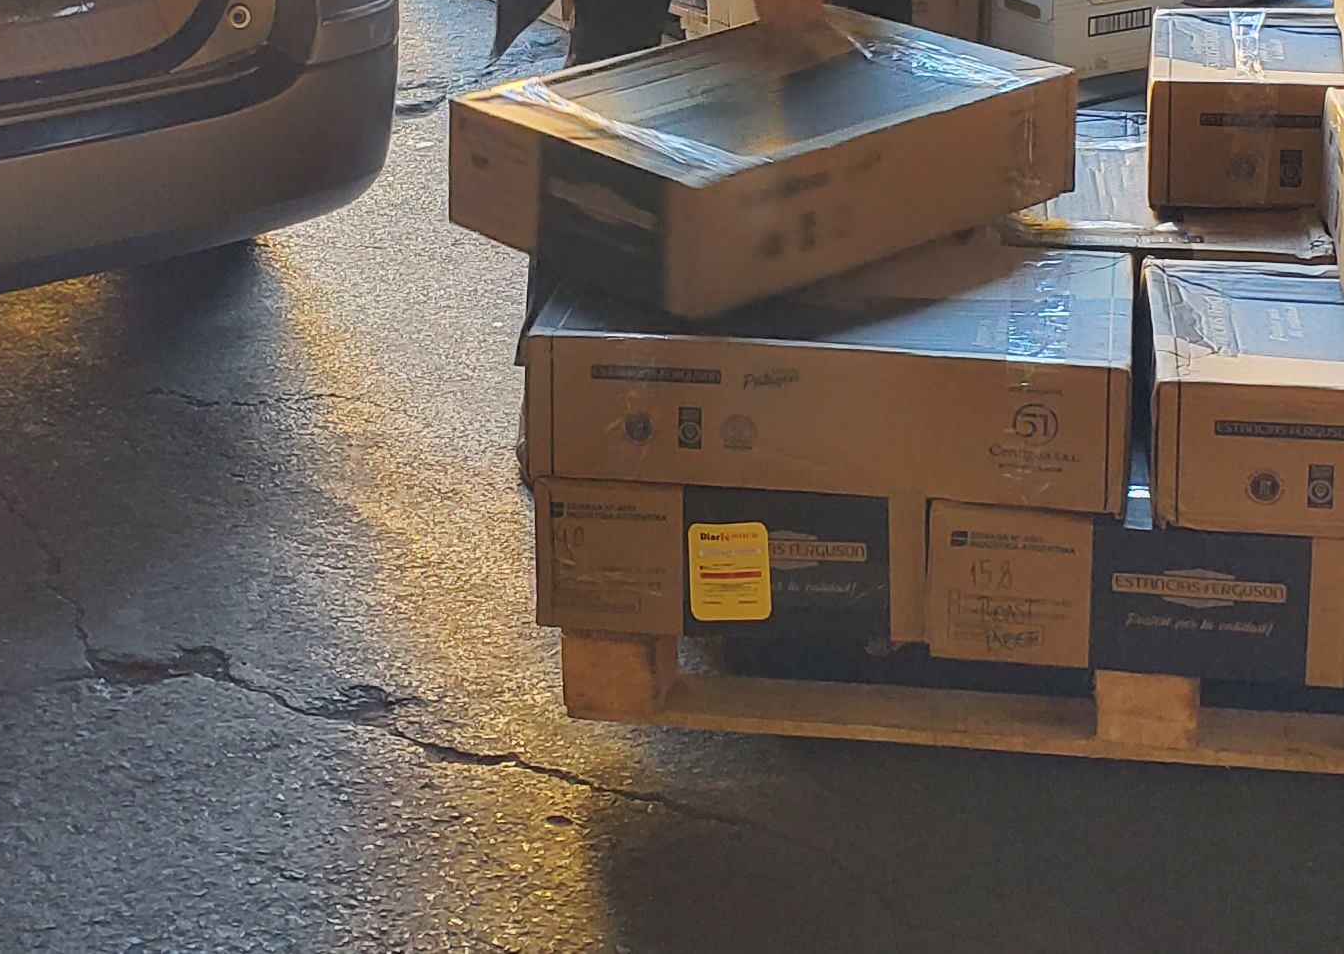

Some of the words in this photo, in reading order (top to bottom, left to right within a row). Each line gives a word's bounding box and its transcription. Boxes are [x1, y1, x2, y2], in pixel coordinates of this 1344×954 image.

[1015, 409, 1054, 440] 51
[789, 544, 866, 560] FERGUSON
[1115, 575, 1201, 594] ESTANCIAS
[1205, 580, 1285, 600] FERGUSON
